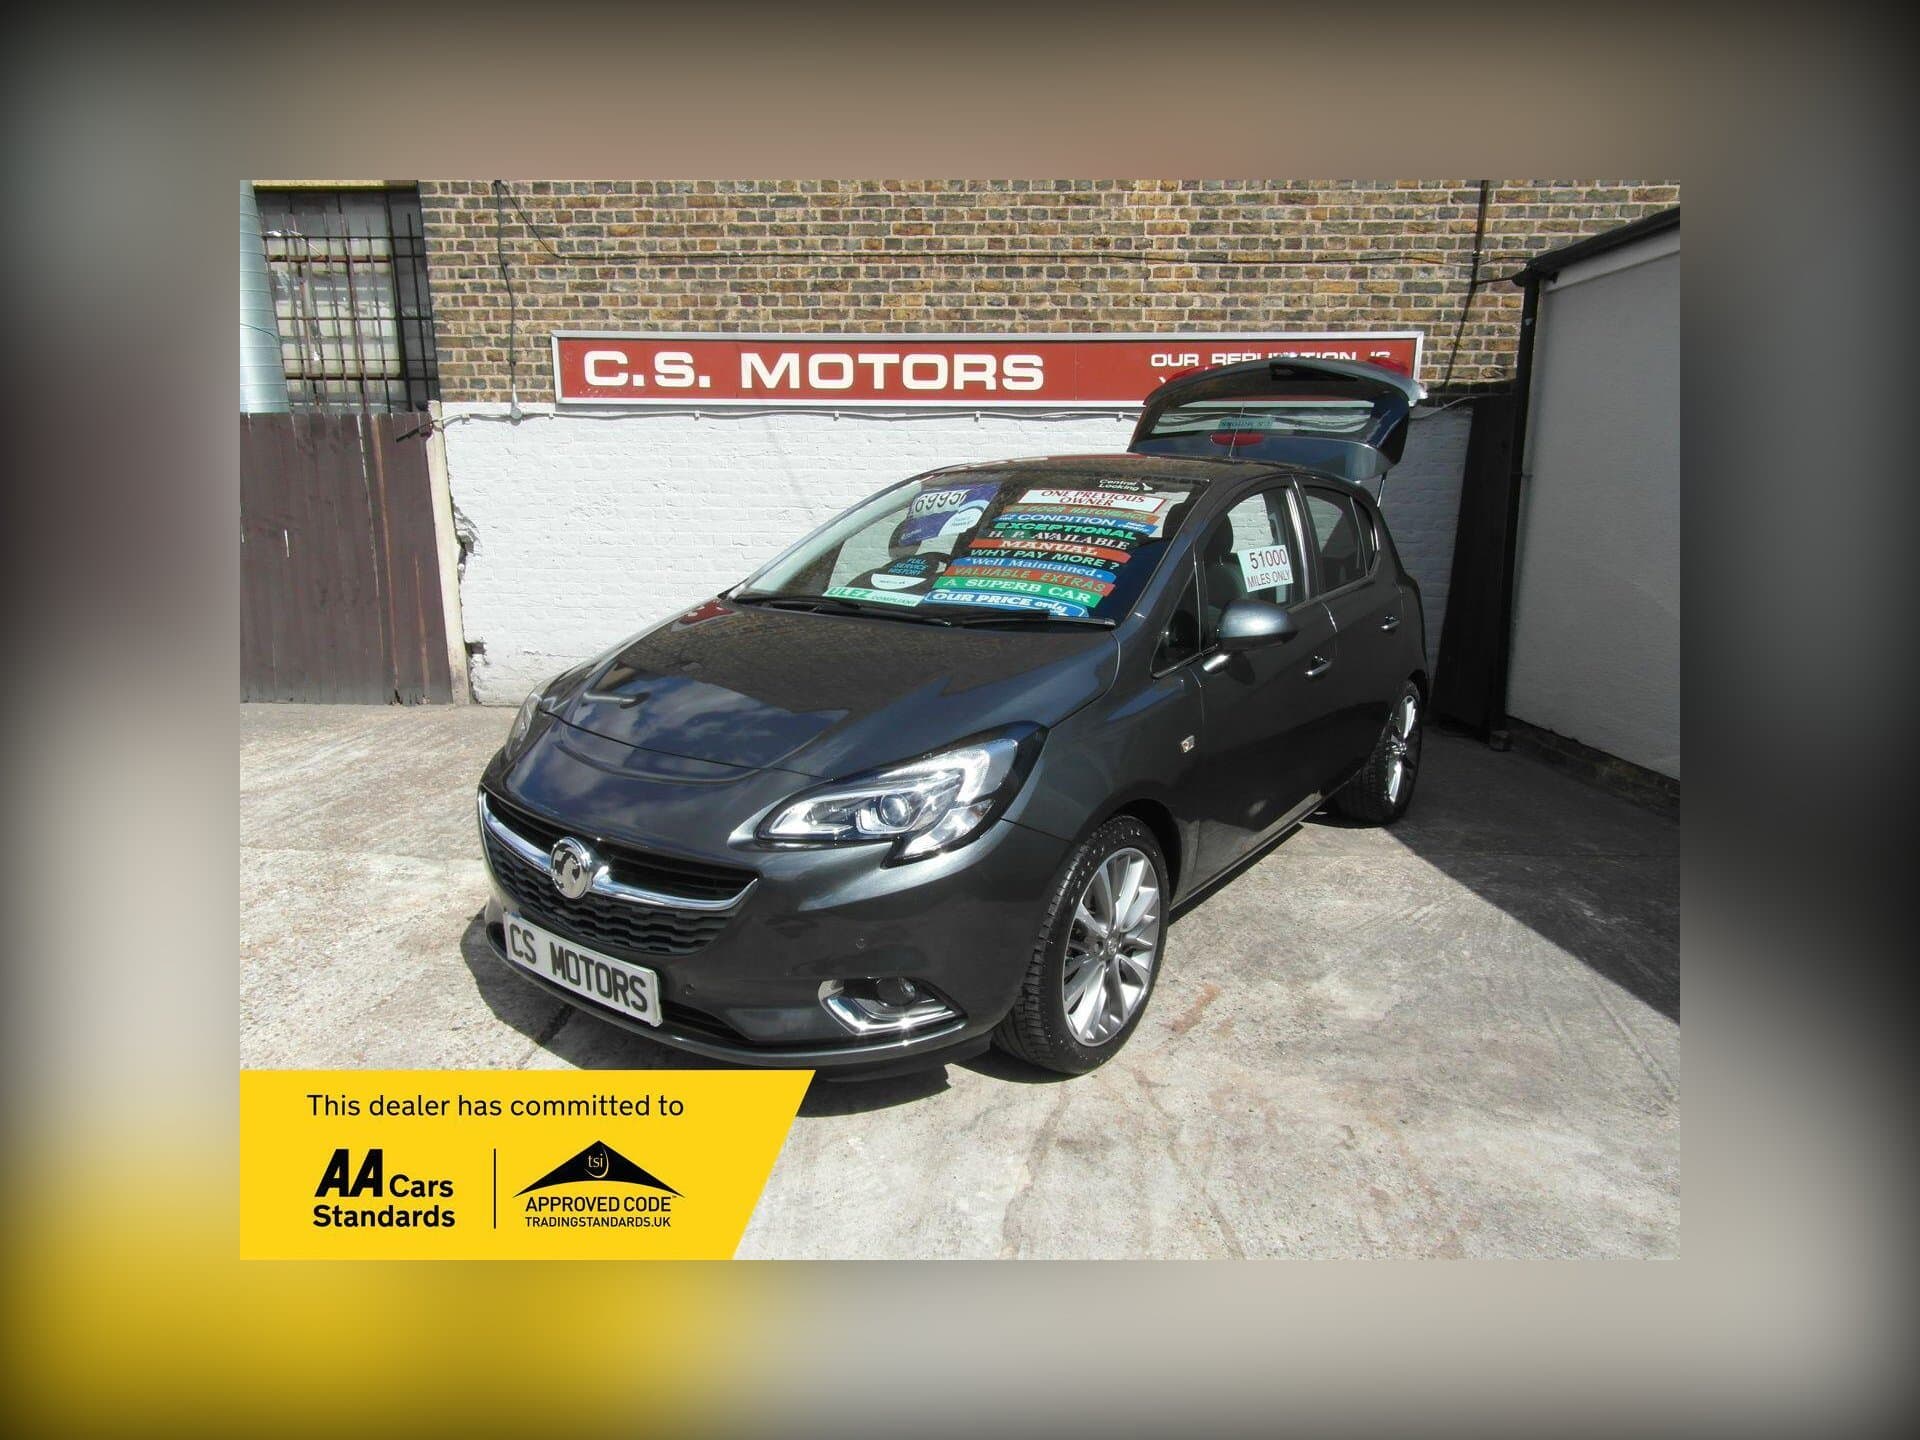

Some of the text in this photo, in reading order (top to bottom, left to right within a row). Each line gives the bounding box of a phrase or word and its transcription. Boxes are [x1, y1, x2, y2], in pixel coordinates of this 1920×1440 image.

[1151, 353, 1199, 367] OUR
[583, 351, 1044, 390] C.S. MOTORS
[1040, 489, 1145, 503] ONE PREVIOUS
[1059, 497, 1114, 506] OWNER
[1017, 514, 1117, 526] CONDITION
[994, 522, 1137, 540] EXCEPTIONAL
[1000, 540, 1099, 556] MANUAL
[1032, 532, 1130, 550] AVAILABLE
[971, 549, 1010, 557] WHY
[1013, 550, 1049, 559] PAY
[1053, 552, 1105, 568] MORE
[1249, 549, 1288, 570] 51000
[954, 567, 1106, 592] VALUABLE EXTRAS
[1247, 570, 1291, 588] MILES ONLY
[827, 587, 874, 598] ULEZ
[943, 578, 1092, 603] A SUPERB CAR
[932, 593, 1068, 614] OUR PRICE only
[509, 923, 648, 1012] CS MOTORS
